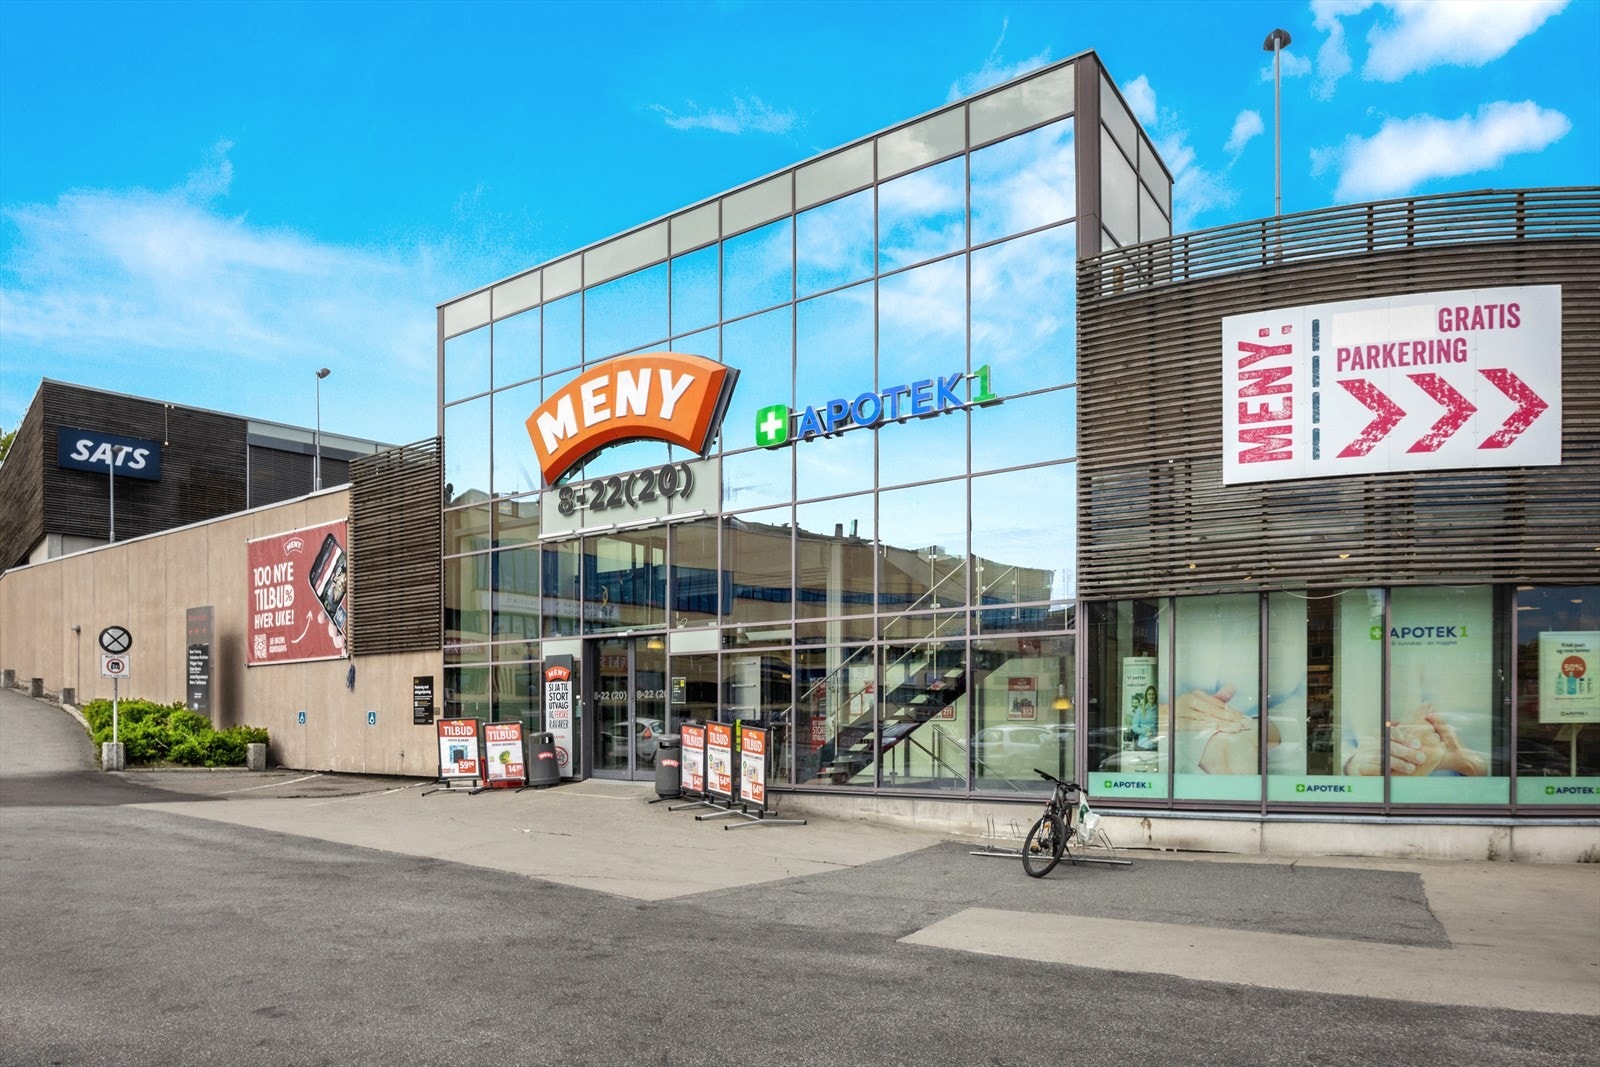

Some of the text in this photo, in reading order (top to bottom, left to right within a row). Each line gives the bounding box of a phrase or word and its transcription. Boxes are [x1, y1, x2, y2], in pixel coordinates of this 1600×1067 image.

[1438, 302, 1521, 333] GRATIS
[1336, 337, 1468, 372] PARKERING
[1238, 324, 1293, 464] MENY:
[797, 364, 997, 440] APOTEK 1
[536, 367, 696, 456] MENY
[70, 439, 150, 470] SATS
[286, 540, 302, 552] MENY
[254, 561, 294, 587] 100 NYE
[254, 584, 295, 611] TILBUD
[254, 609, 295, 629] HVER UKE!
[1390, 625, 1469, 638] APOTEK 1
[1563, 663, 1584, 671] 50%
[548, 669, 567, 679] MENY
[548, 682, 569, 692] SI JA TIL
[548, 692, 569, 701] STORT
[594, 690, 627, 700] 8-22 (20)
[636, 690, 654, 699] 8-22
[548, 701, 569, 710] UTVALG
[443, 725, 474, 736] TILBUD
[488, 729, 519, 741] TILBUD
[683, 734, 704, 747] TILBUD
[709, 732, 729, 745] TILBUD
[743, 737, 763, 752] TILBUD
[1113, 781, 1147, 789] APOTEK
[1306, 785, 1353, 793] APOTEK 1
[1556, 786, 1594, 794] APOTEK
